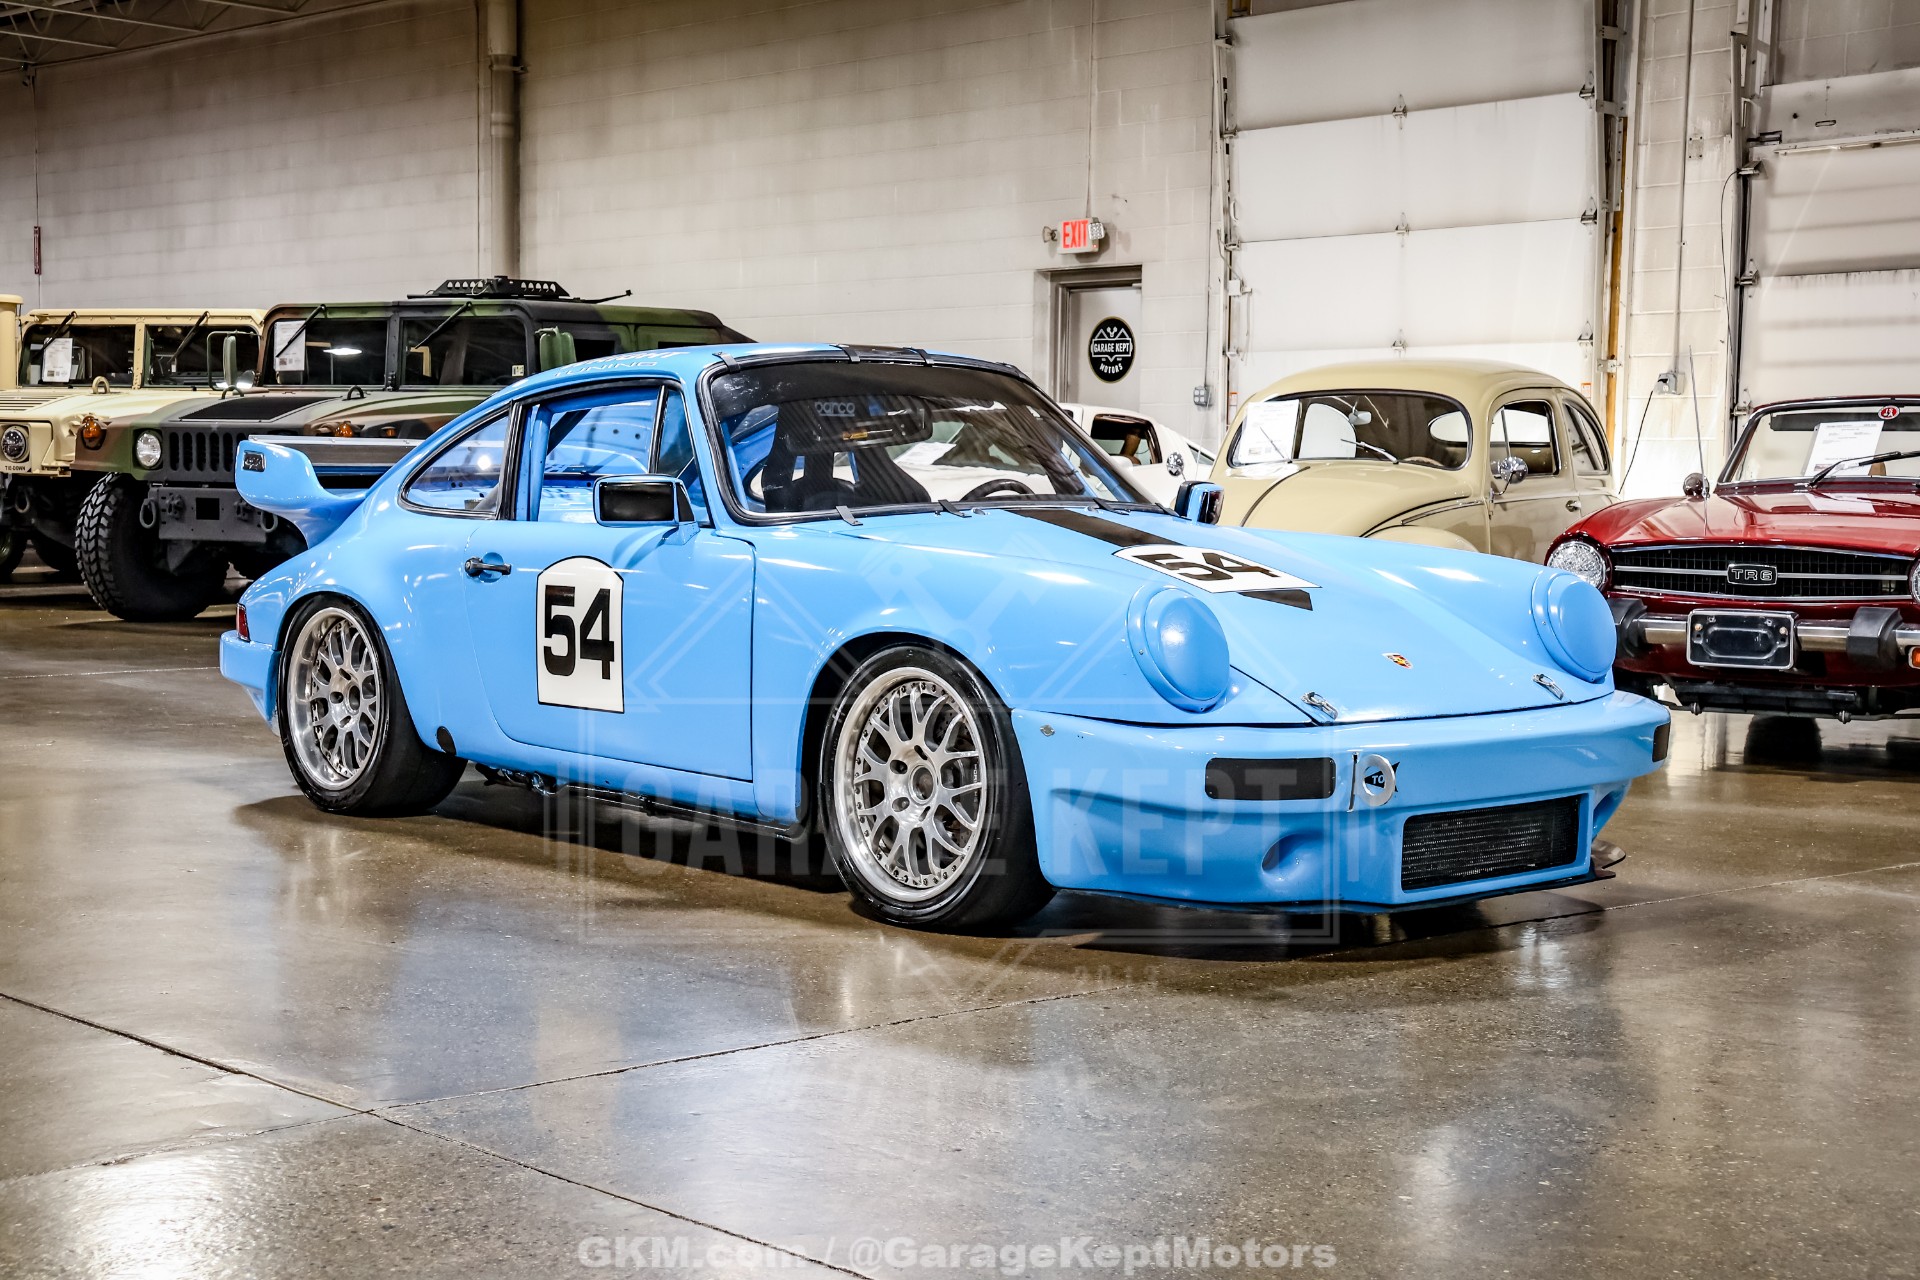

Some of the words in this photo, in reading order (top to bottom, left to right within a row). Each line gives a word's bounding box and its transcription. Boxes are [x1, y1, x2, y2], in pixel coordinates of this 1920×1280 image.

[1062, 219, 1089, 248] EXIT
[1094, 343, 1115, 352] GARAGE
[1115, 343, 1130, 352] KEPT
[1100, 363, 1123, 374] MOTORS
[1131, 553, 1281, 582] 54
[1731, 568, 1773, 581] TR6
[543, 584, 615, 681] 54
